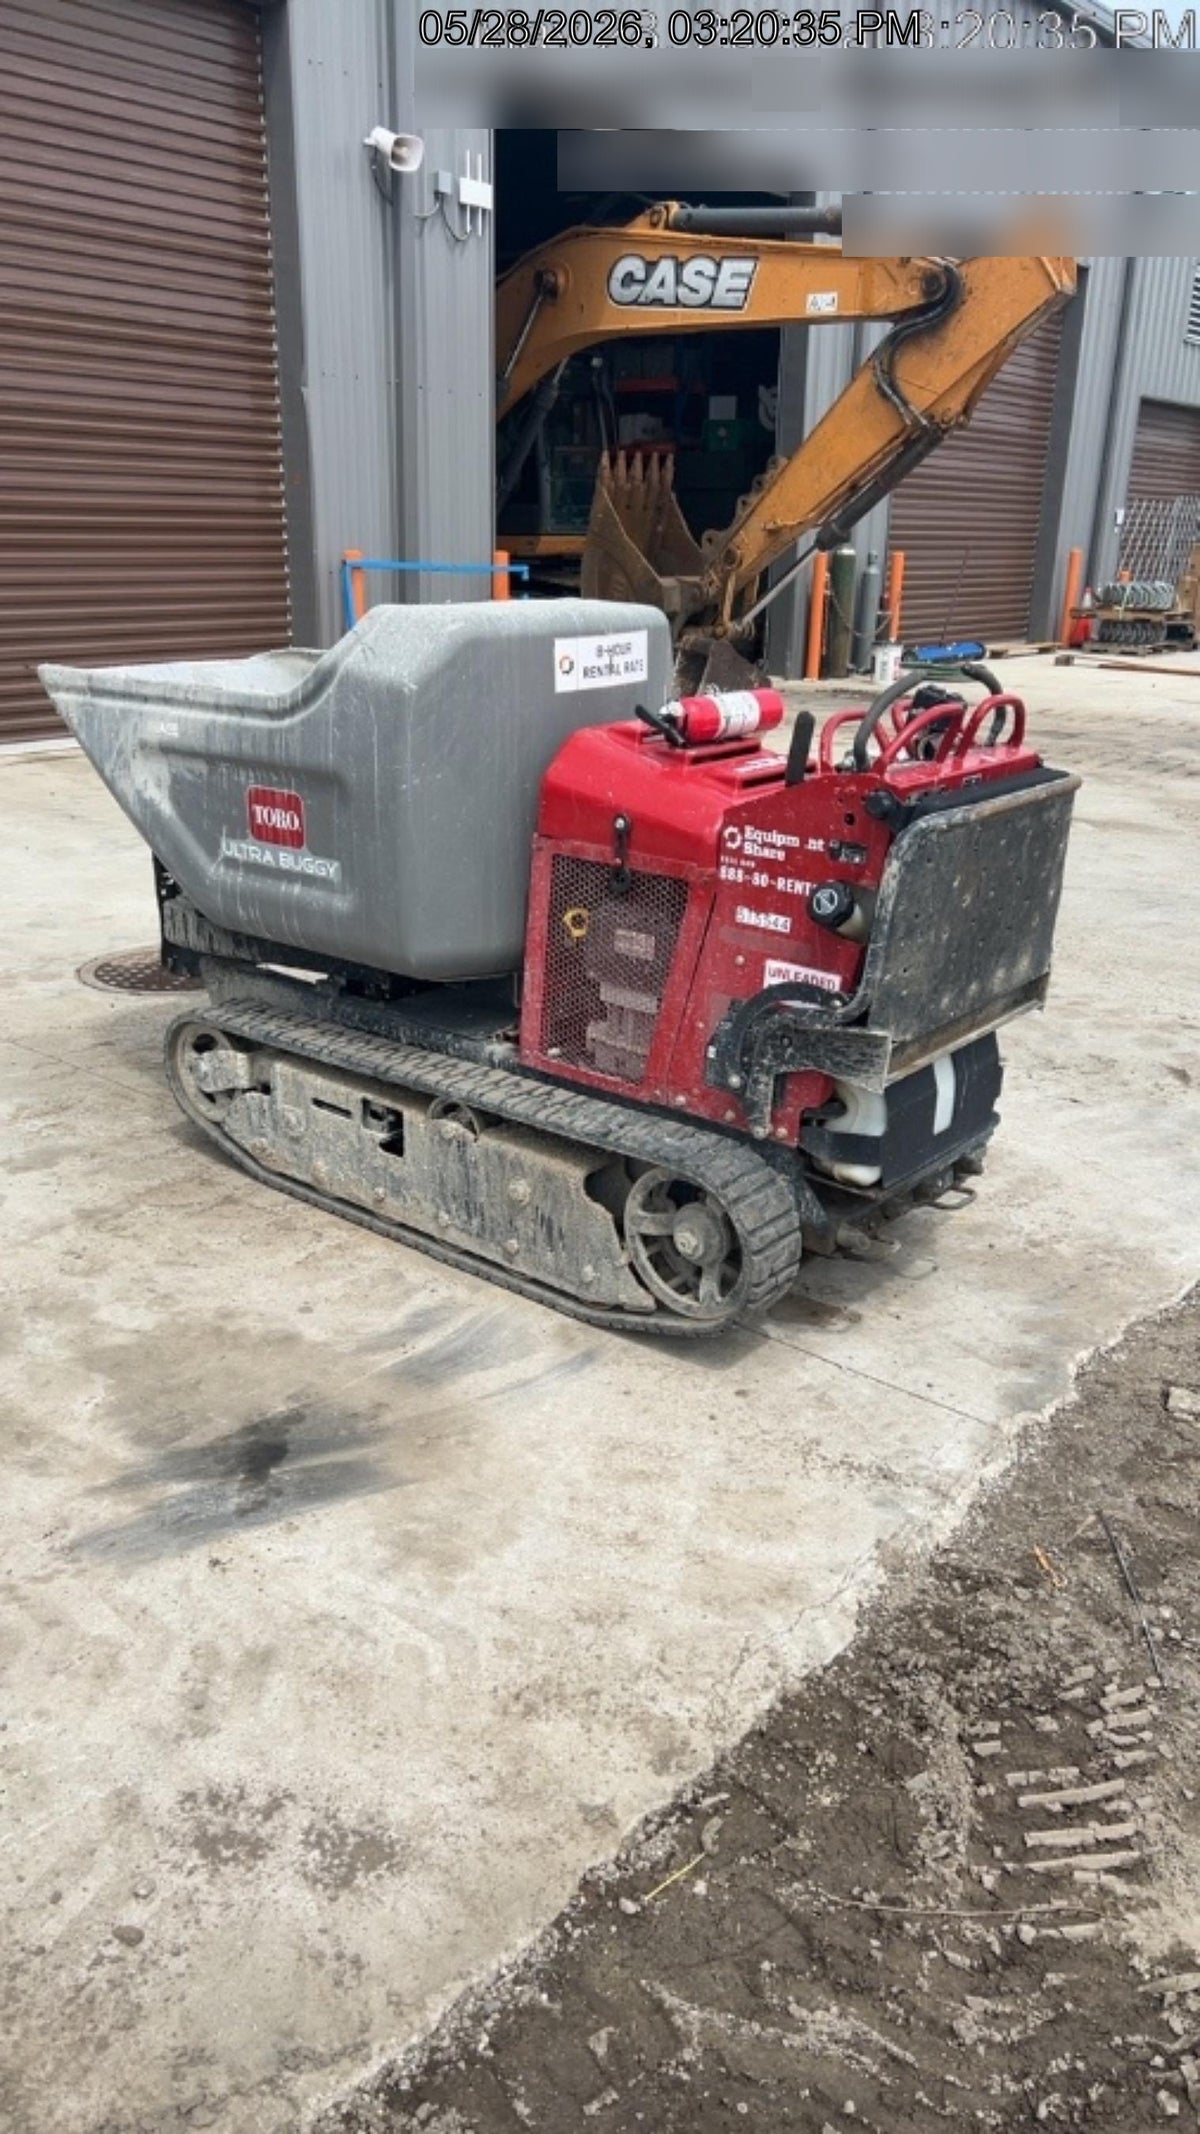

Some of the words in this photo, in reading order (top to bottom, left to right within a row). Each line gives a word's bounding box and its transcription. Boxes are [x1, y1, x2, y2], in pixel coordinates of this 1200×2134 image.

[607, 253, 759, 311] CASE
[252, 804, 301, 831] TORO
[743, 841, 786, 862] Share
[744, 825, 826, 851] Equipmnt
[221, 838, 276, 866] ULTRA
[279, 851, 339, 879] BUGGY
[719, 865, 818, 897] 888-80-RENT
